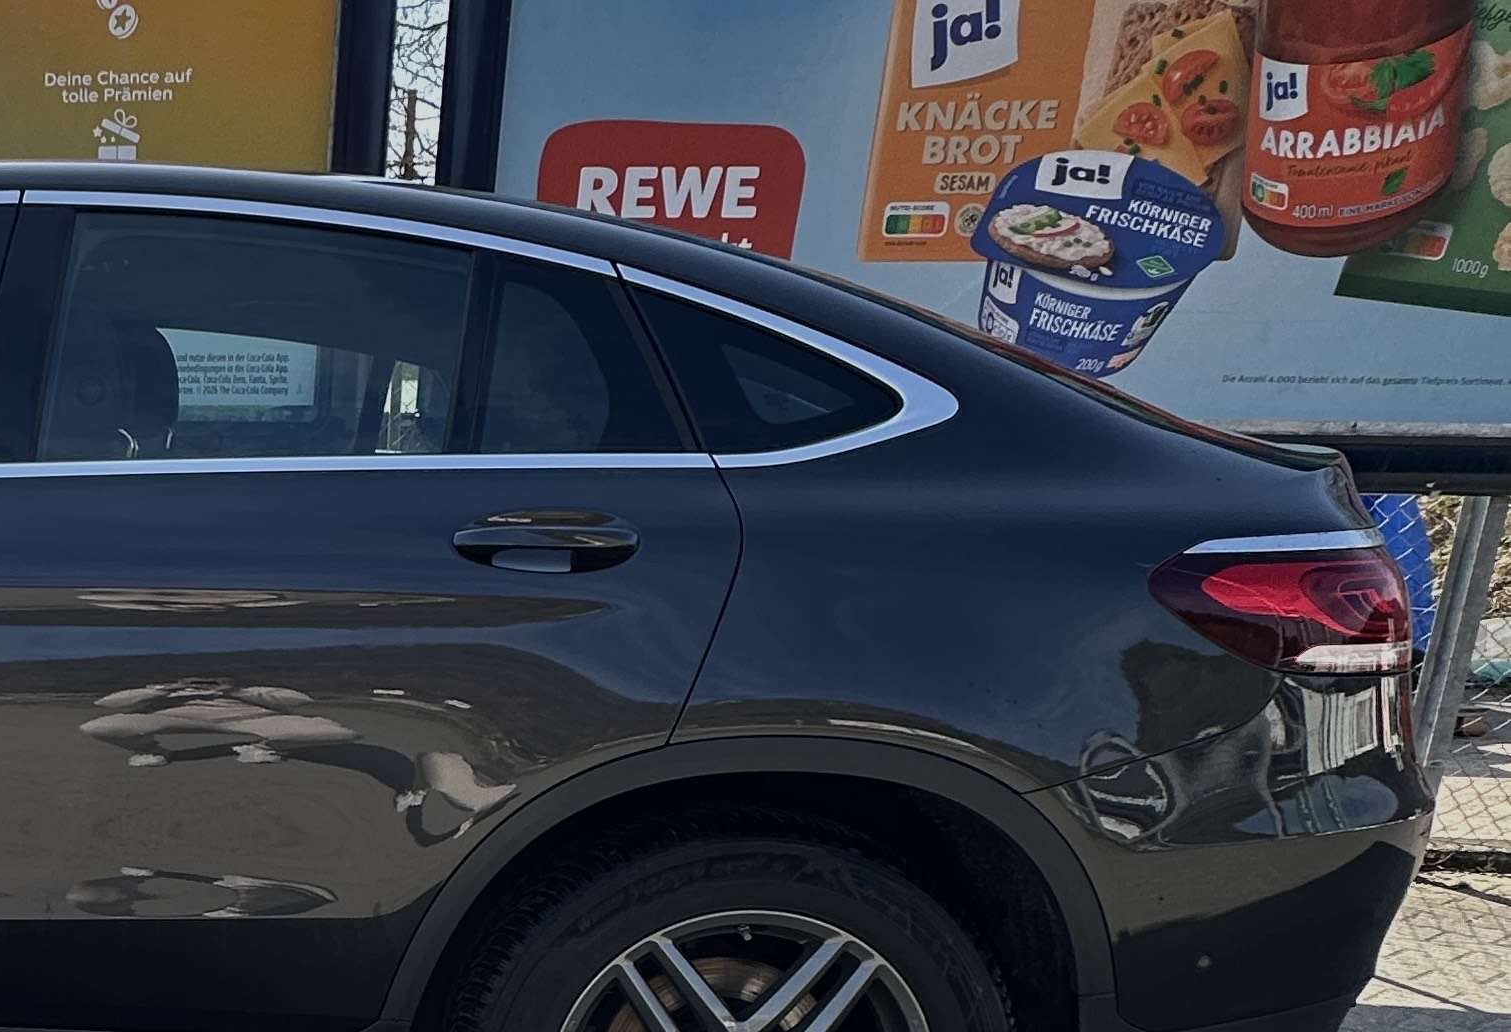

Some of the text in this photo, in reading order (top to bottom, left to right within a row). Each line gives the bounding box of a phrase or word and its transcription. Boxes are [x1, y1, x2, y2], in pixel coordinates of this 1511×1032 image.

[931, 0, 1001, 72] ja!
[44, 68, 193, 87] Deine Chance auf
[1266, 71, 1298, 111] ja!
[62, 86, 173, 103] tolle Prämien
[897, 92, 1060, 132] KNÄCKE
[922, 134, 1024, 165] BROT
[939, 174, 990, 191] SESAM
[1051, 157, 1111, 185] ja!
[576, 166, 761, 219] REWE
[1085, 205, 1208, 248] FRISCHKÄSE
[1127, 199, 1212, 232] KÖRNIGER
[1292, 204, 1316, 218] 400
[1035, 291, 1091, 319] KÖRNIGER
[1028, 307, 1123, 342] FRISCHKÄSE
[1222, 374, 1236, 384] Die
